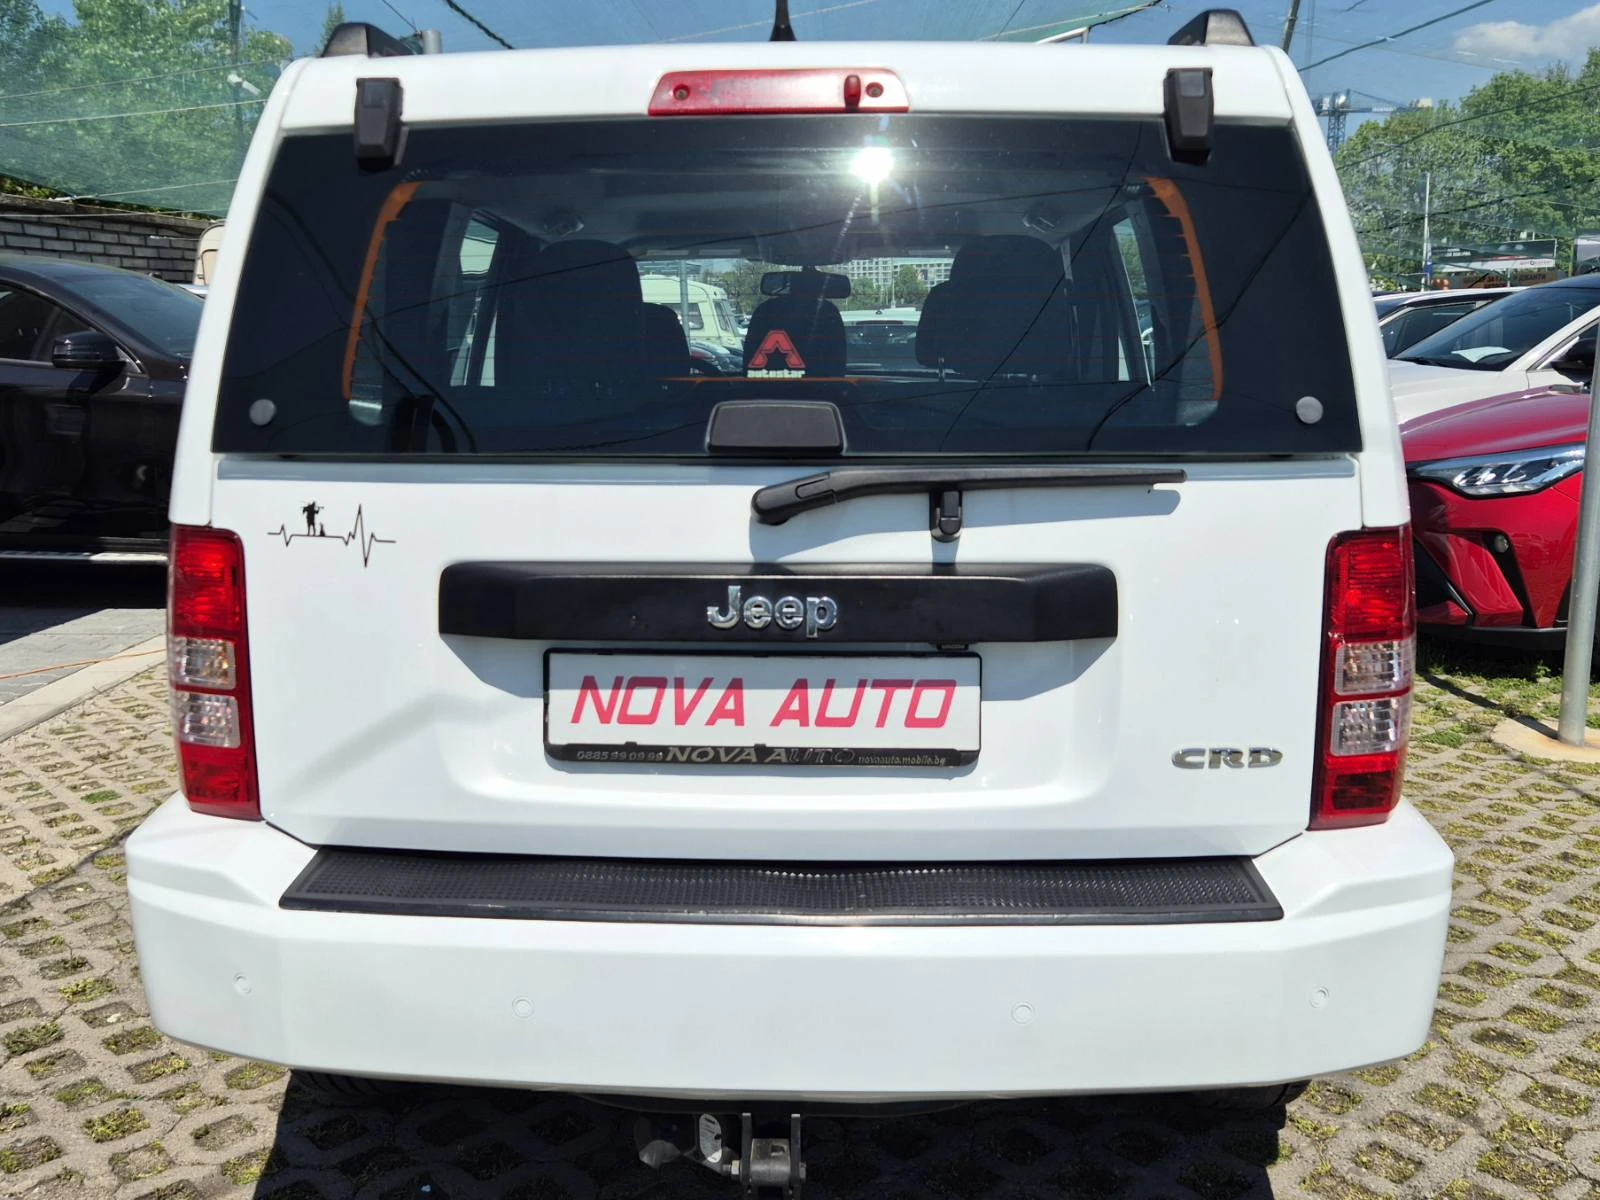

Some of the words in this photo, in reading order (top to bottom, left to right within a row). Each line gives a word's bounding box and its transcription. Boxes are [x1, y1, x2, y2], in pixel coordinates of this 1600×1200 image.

[707, 585, 838, 639] Jeep
[570, 675, 745, 727] NOVA
[769, 678, 957, 728] AUTO
[665, 746, 758, 762] NOVA
[764, 747, 856, 763] AUTO
[1171, 747, 1283, 769] CRD
